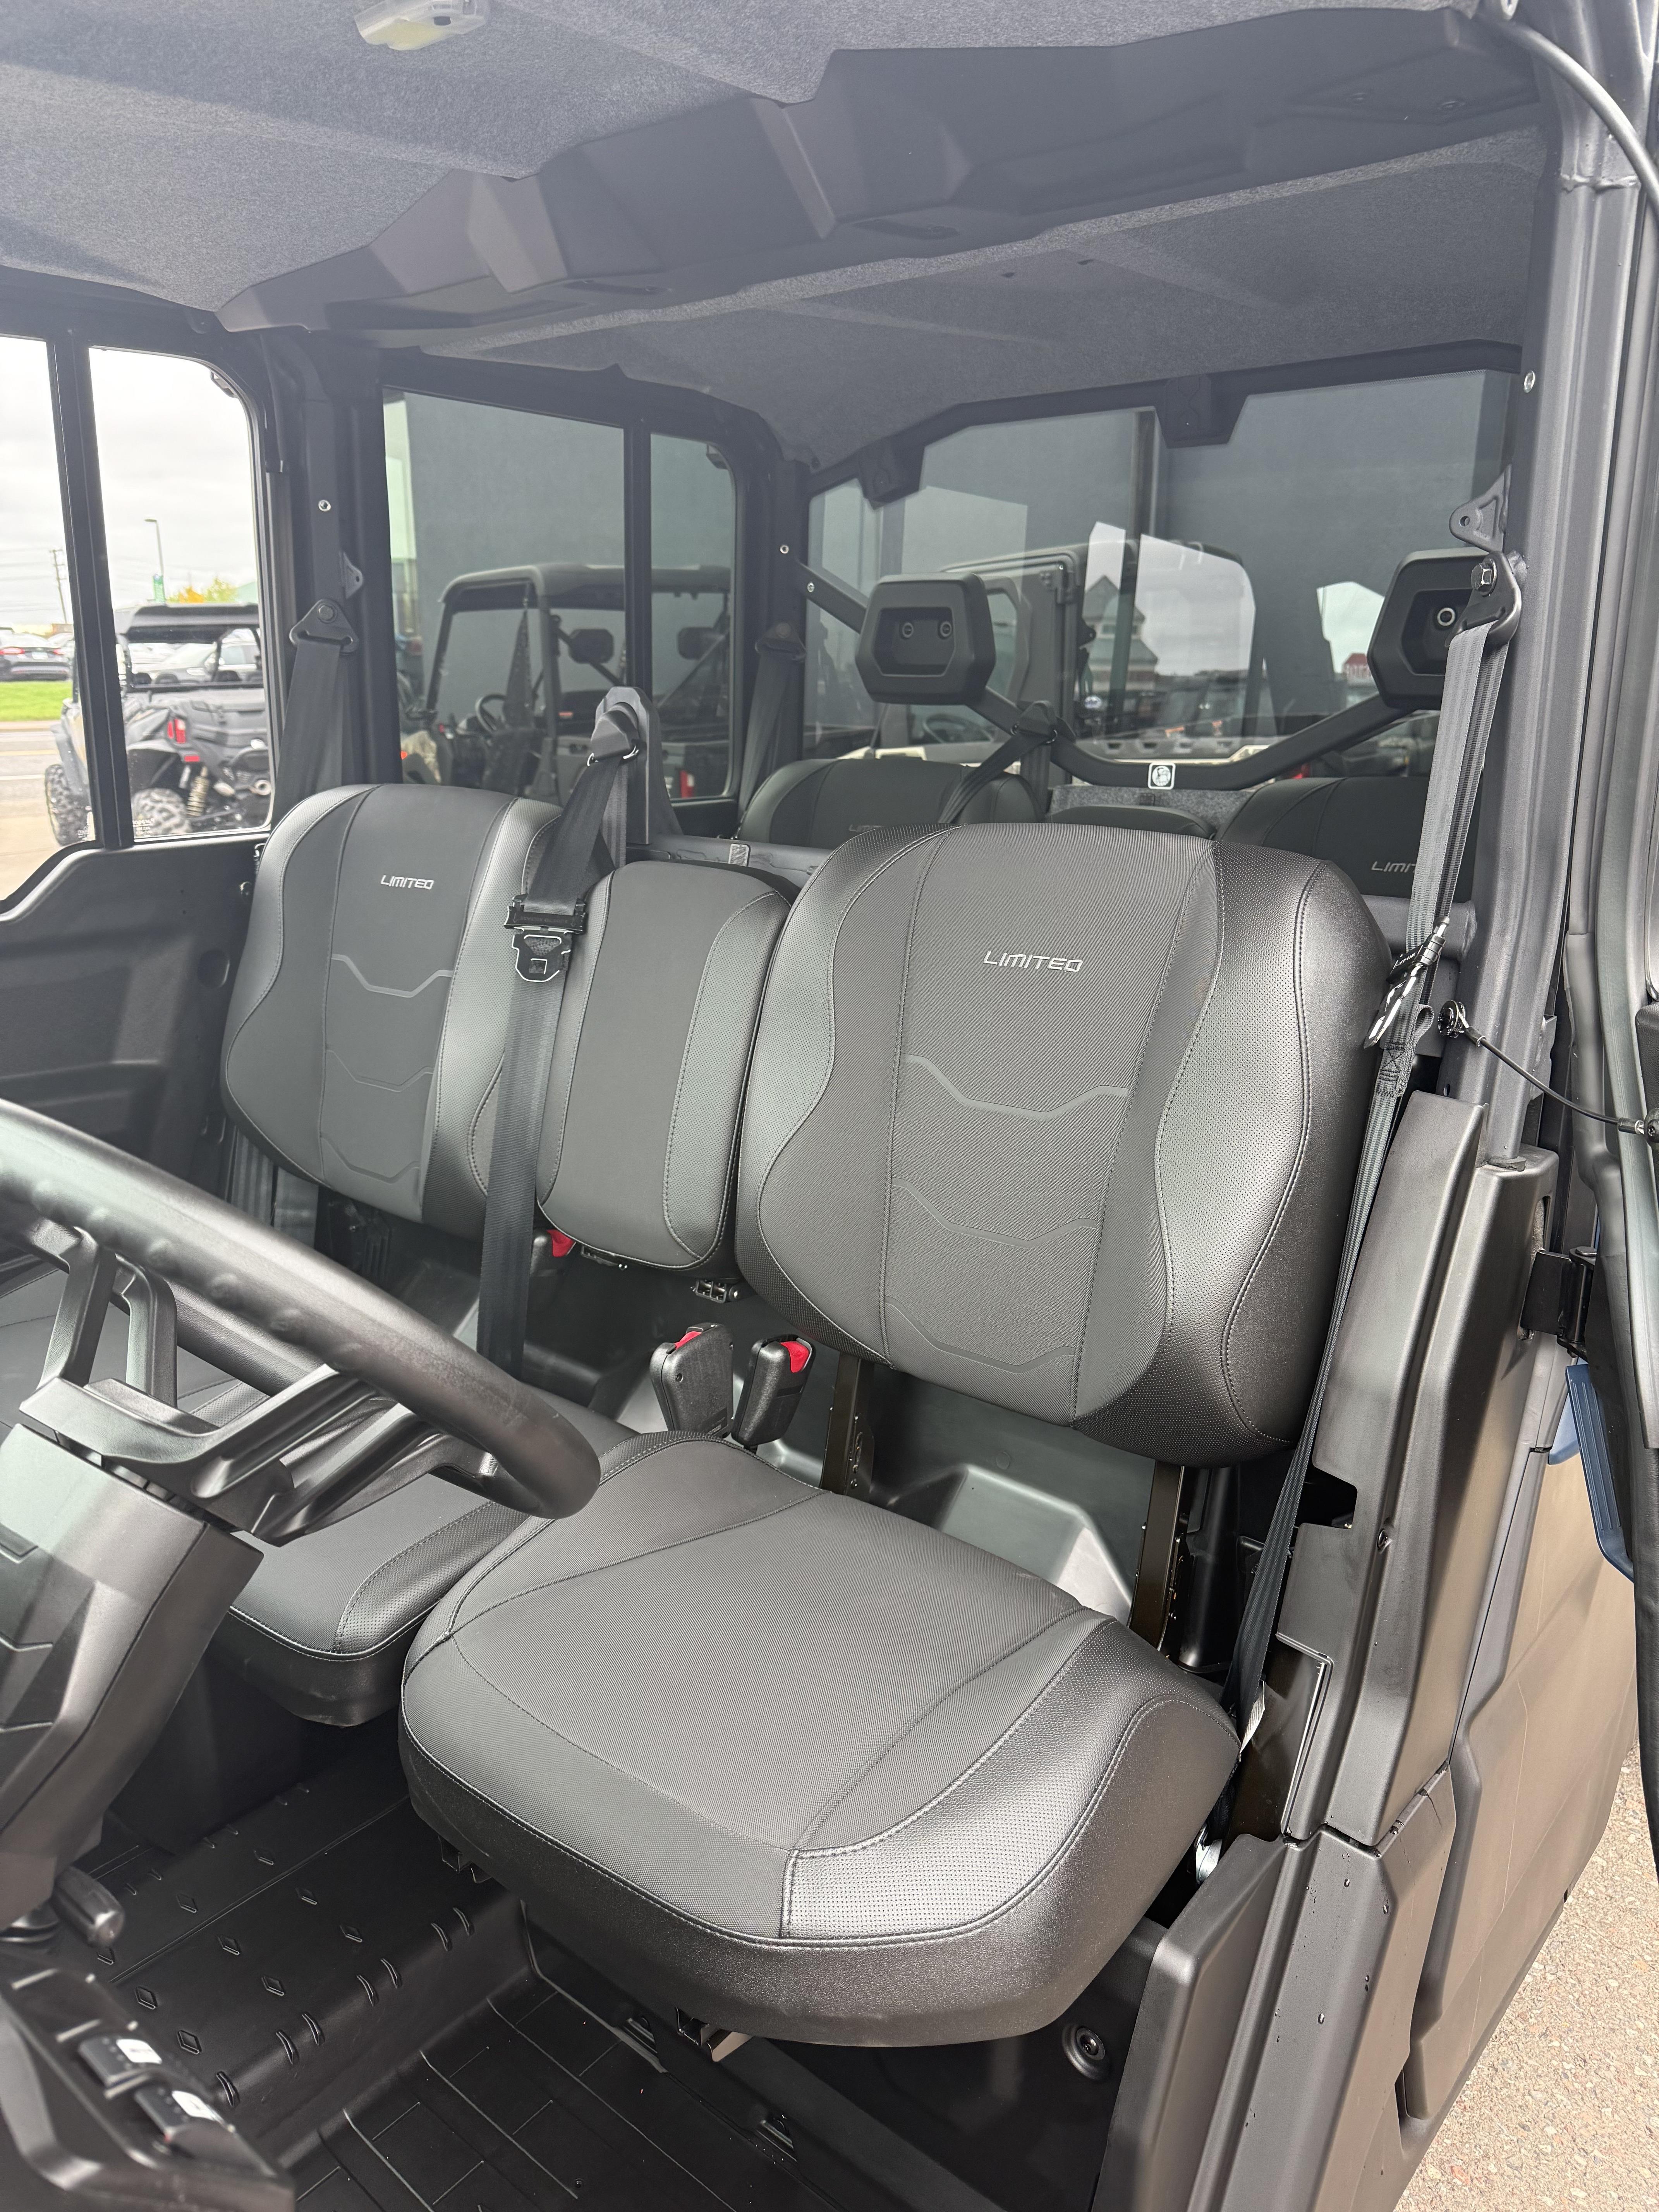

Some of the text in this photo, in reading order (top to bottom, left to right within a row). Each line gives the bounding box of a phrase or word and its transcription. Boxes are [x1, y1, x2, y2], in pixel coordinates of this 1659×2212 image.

[1371, 861, 1416, 873] LIMI
[381, 875, 434, 890] LIMITED
[983, 951, 1083, 972] LIMITED
